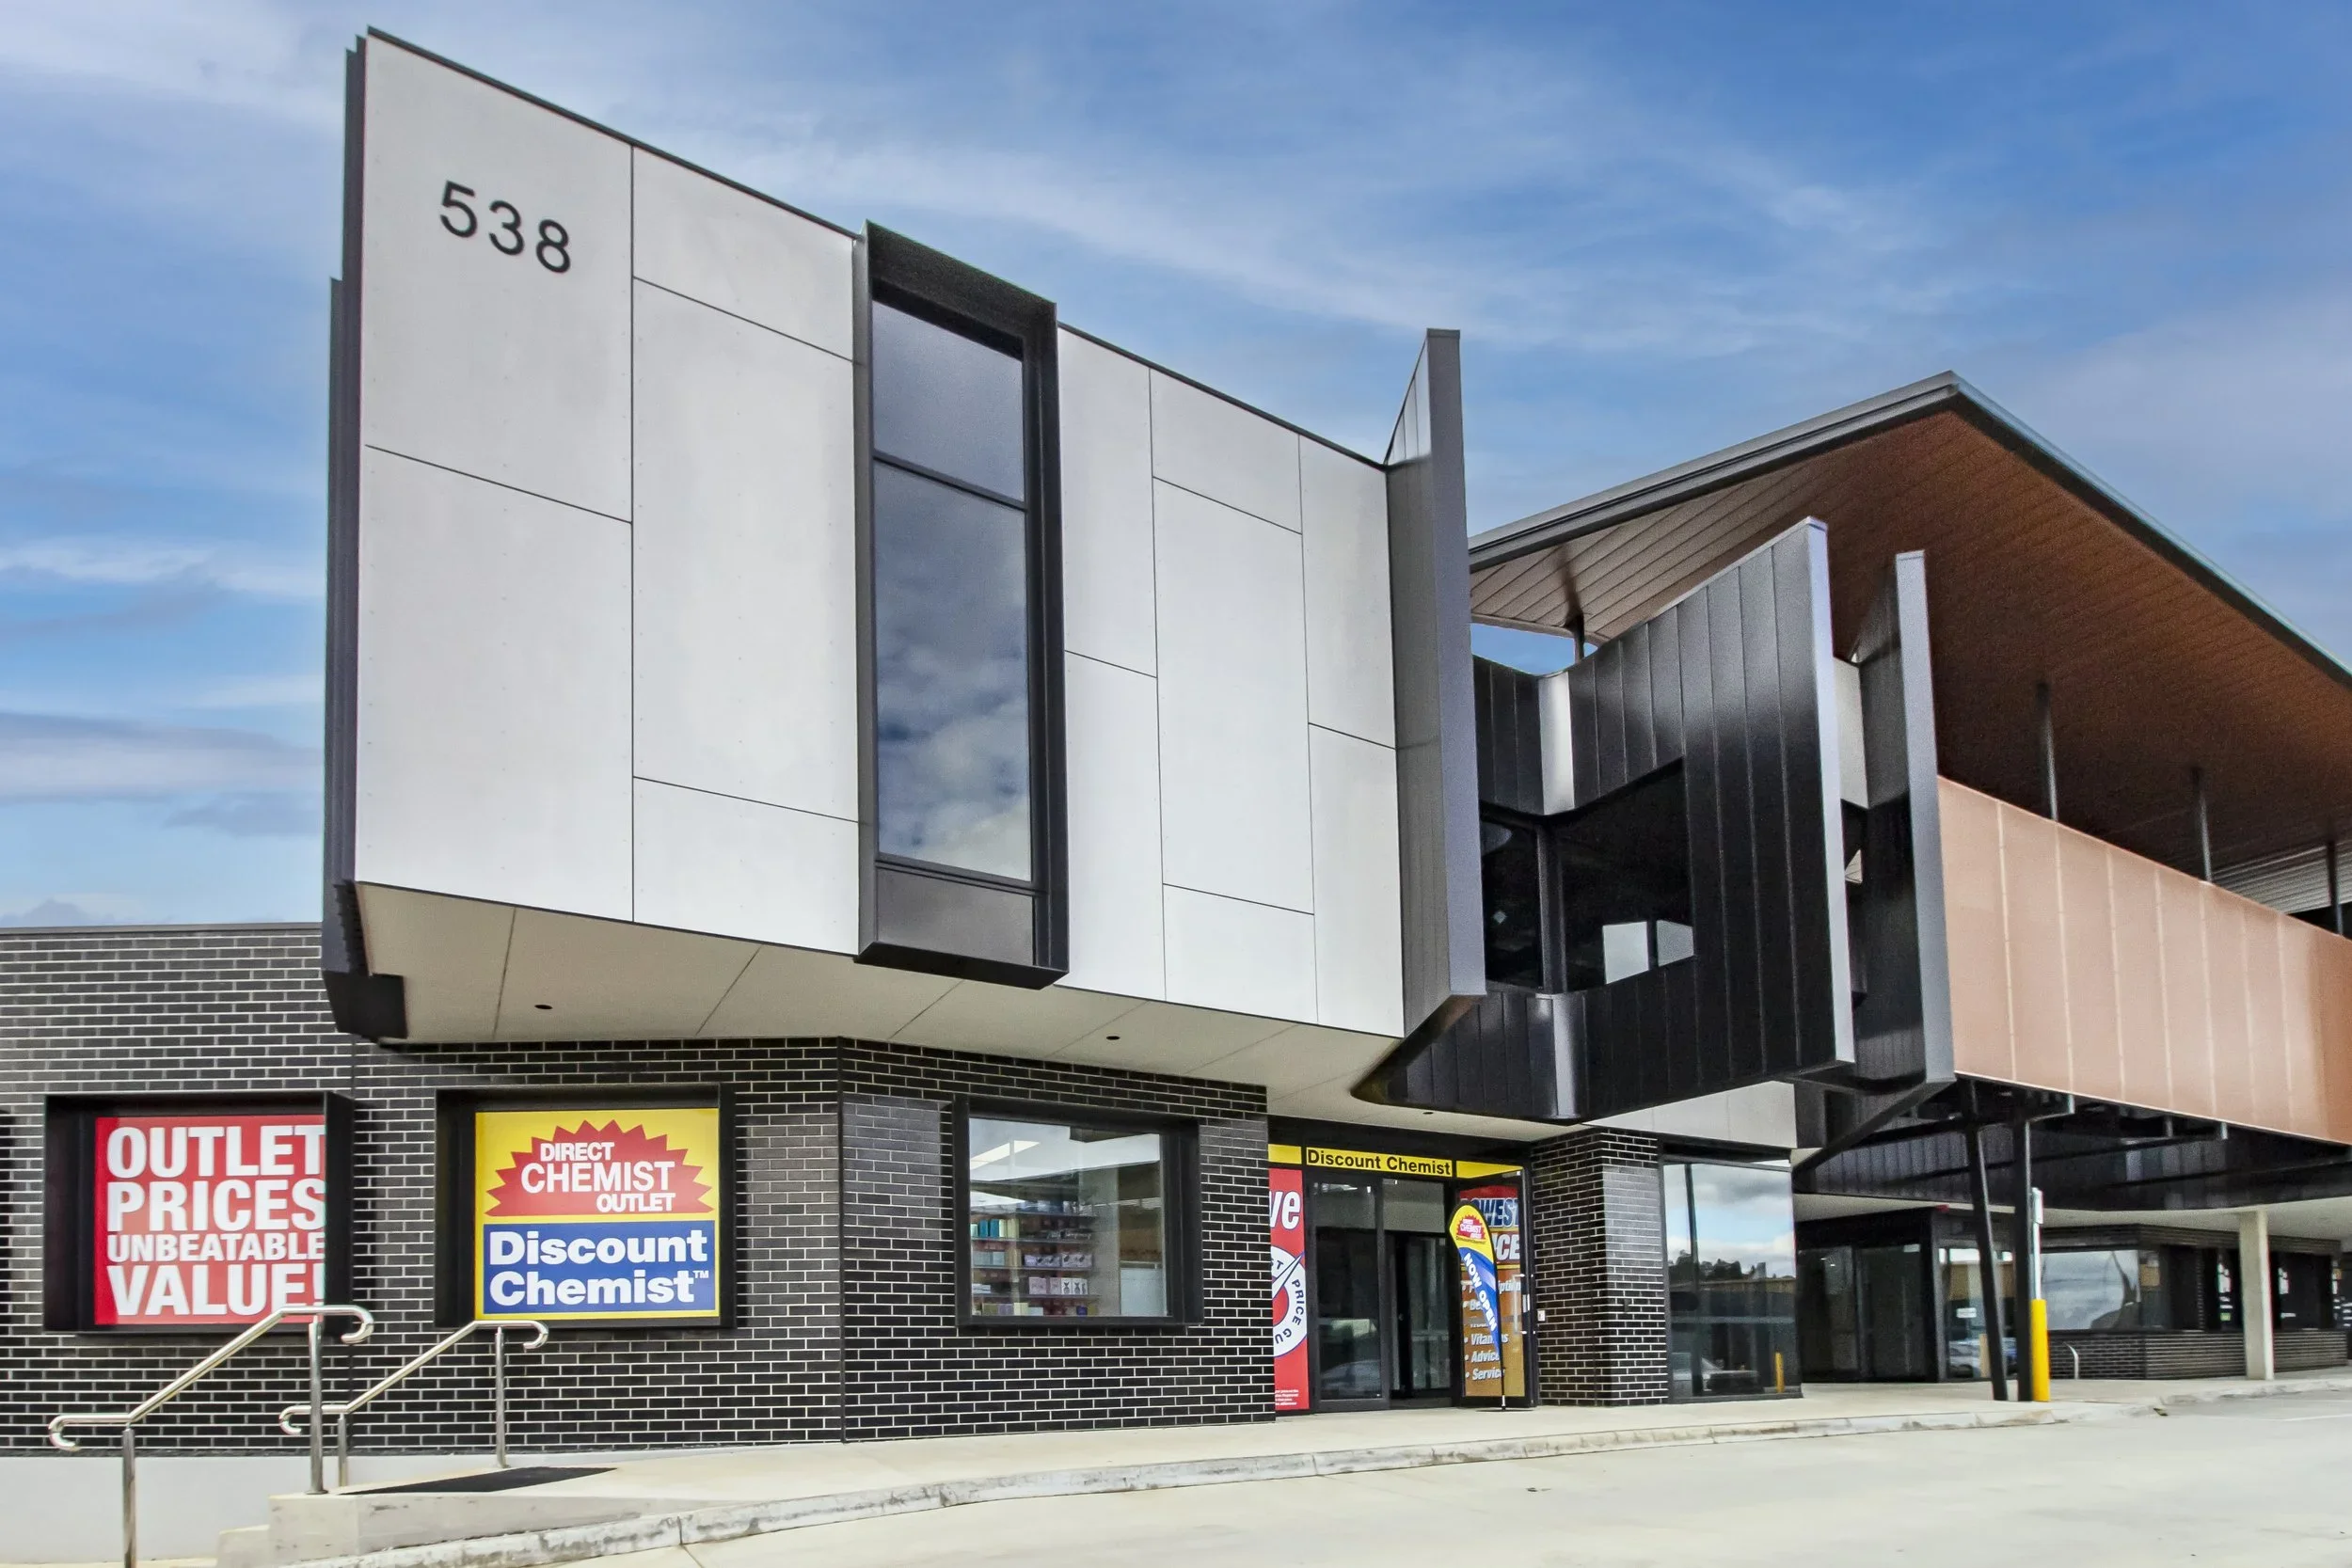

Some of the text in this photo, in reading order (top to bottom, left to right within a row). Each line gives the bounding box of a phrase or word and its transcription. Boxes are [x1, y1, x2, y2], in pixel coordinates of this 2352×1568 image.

[439, 180, 571, 274] 538
[106, 1125, 326, 1179] OUTLET
[540, 1142, 614, 1162] DIRECT
[1308, 1149, 1451, 1175] Discount Chemist
[520, 1162, 675, 1194] CHEMIST
[107, 1179, 326, 1232] PRICES
[596, 1193, 675, 1212] OUTLET
[107, 1232, 326, 1263] UNBEATABLE
[489, 1229, 707, 1265] Discount
[1292, 1278, 1305, 1326] PRICE
[1464, 1253, 1482, 1288] NOW
[1479, 1290, 1497, 1331] OPEN
